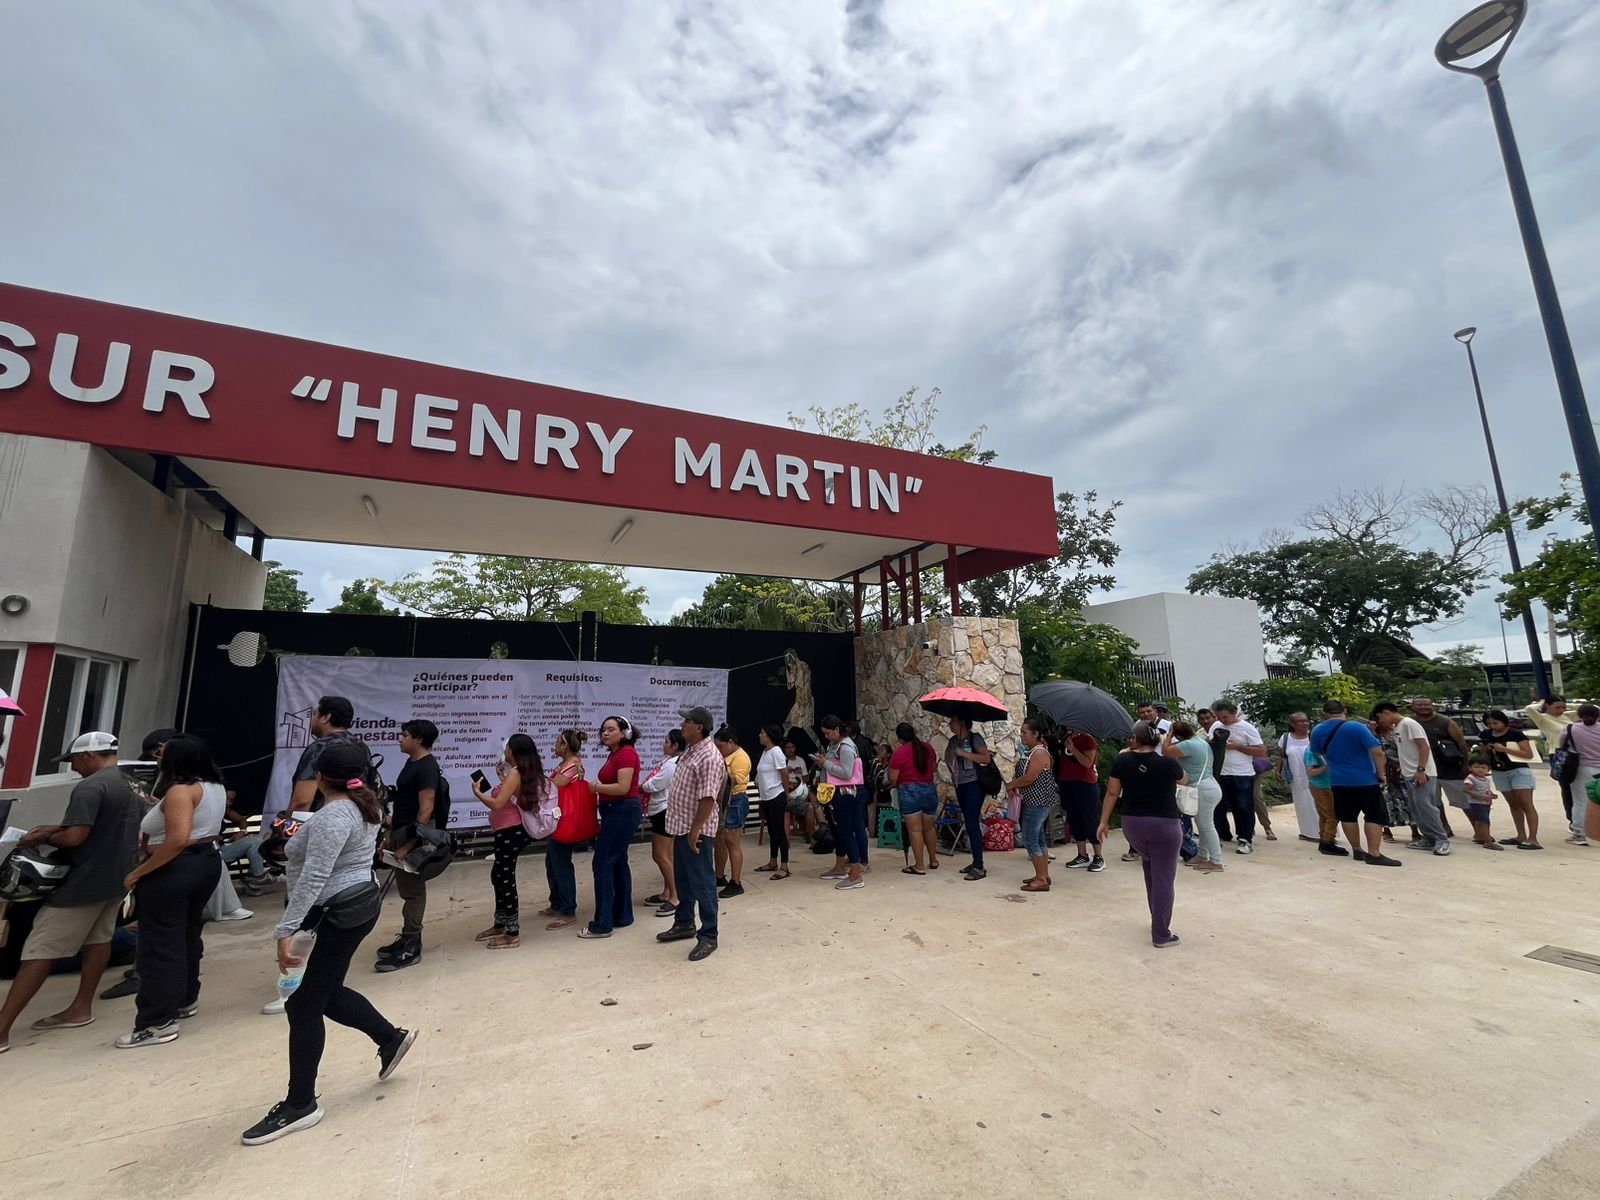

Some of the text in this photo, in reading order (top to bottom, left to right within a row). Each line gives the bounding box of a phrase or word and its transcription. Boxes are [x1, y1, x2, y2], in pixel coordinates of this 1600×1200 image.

[0, 321, 923, 513] SUR “HENRY MARTIN”
[412, 672, 514, 683] ¿Quiénes pueden
[546, 673, 603, 684] Requisitos:
[650, 677, 710, 688] Documentos:
[412, 683, 478, 694] participar?
[350, 716, 396, 728] vienda
[354, 730, 403, 742] nestar
